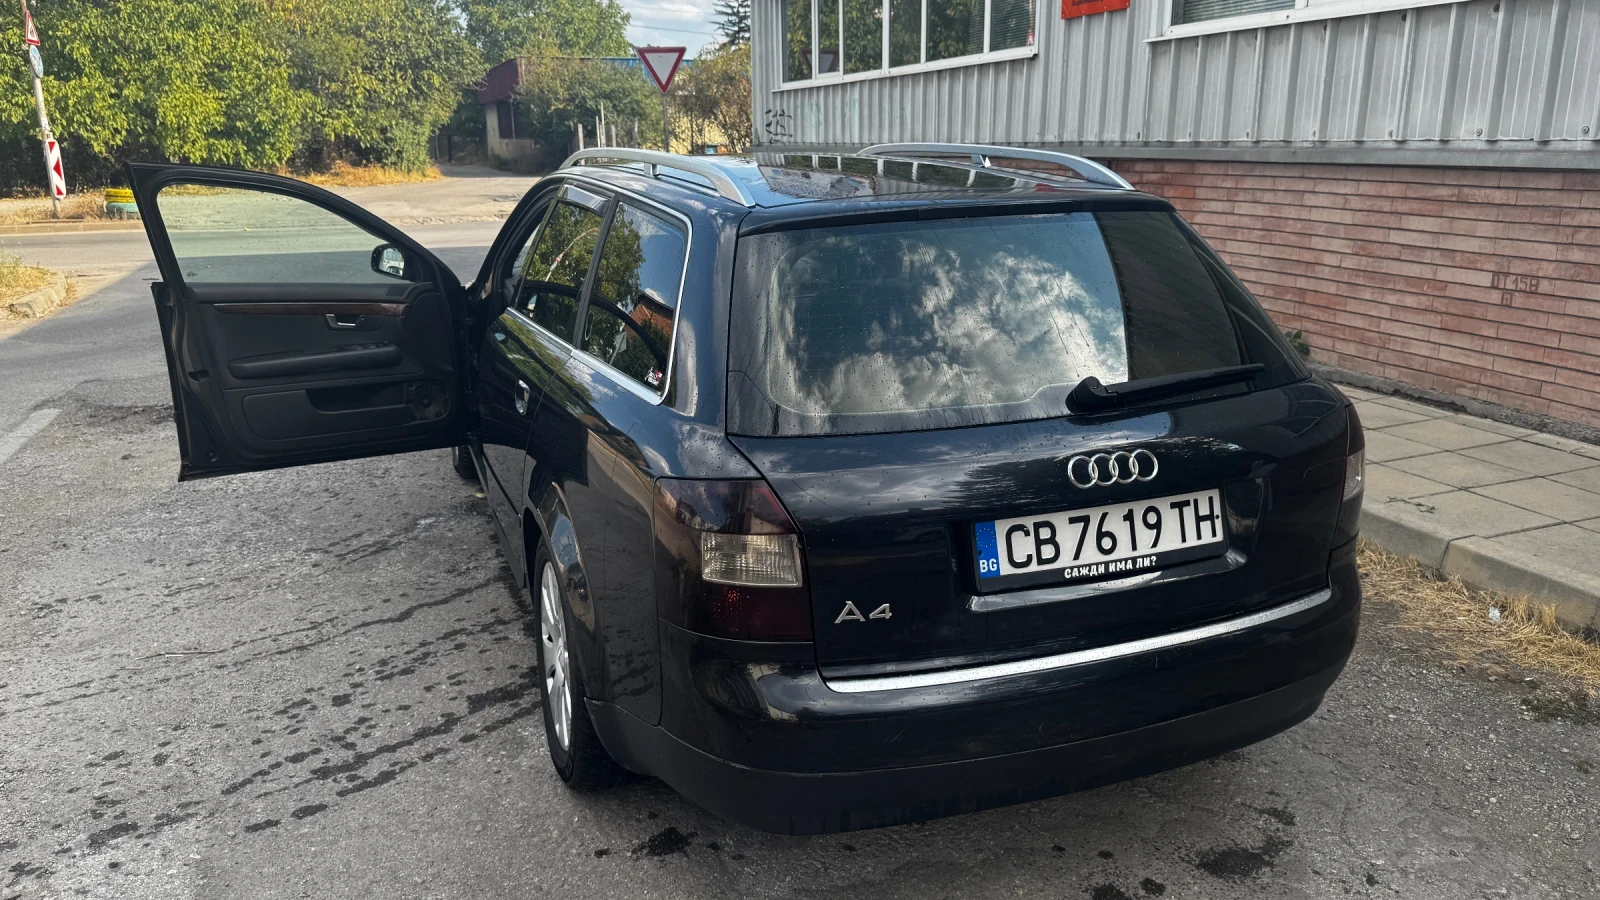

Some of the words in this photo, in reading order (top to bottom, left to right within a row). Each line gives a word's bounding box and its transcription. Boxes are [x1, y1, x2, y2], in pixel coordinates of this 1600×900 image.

[1067, 505, 1162, 561] 7619
[979, 558, 998, 573] BG
[1064, 563, 1105, 579] САЖДИ
[1108, 559, 1133, 573] ИМА
[1136, 556, 1157, 569] ЛИ?
[834, 600, 892, 624] A4
